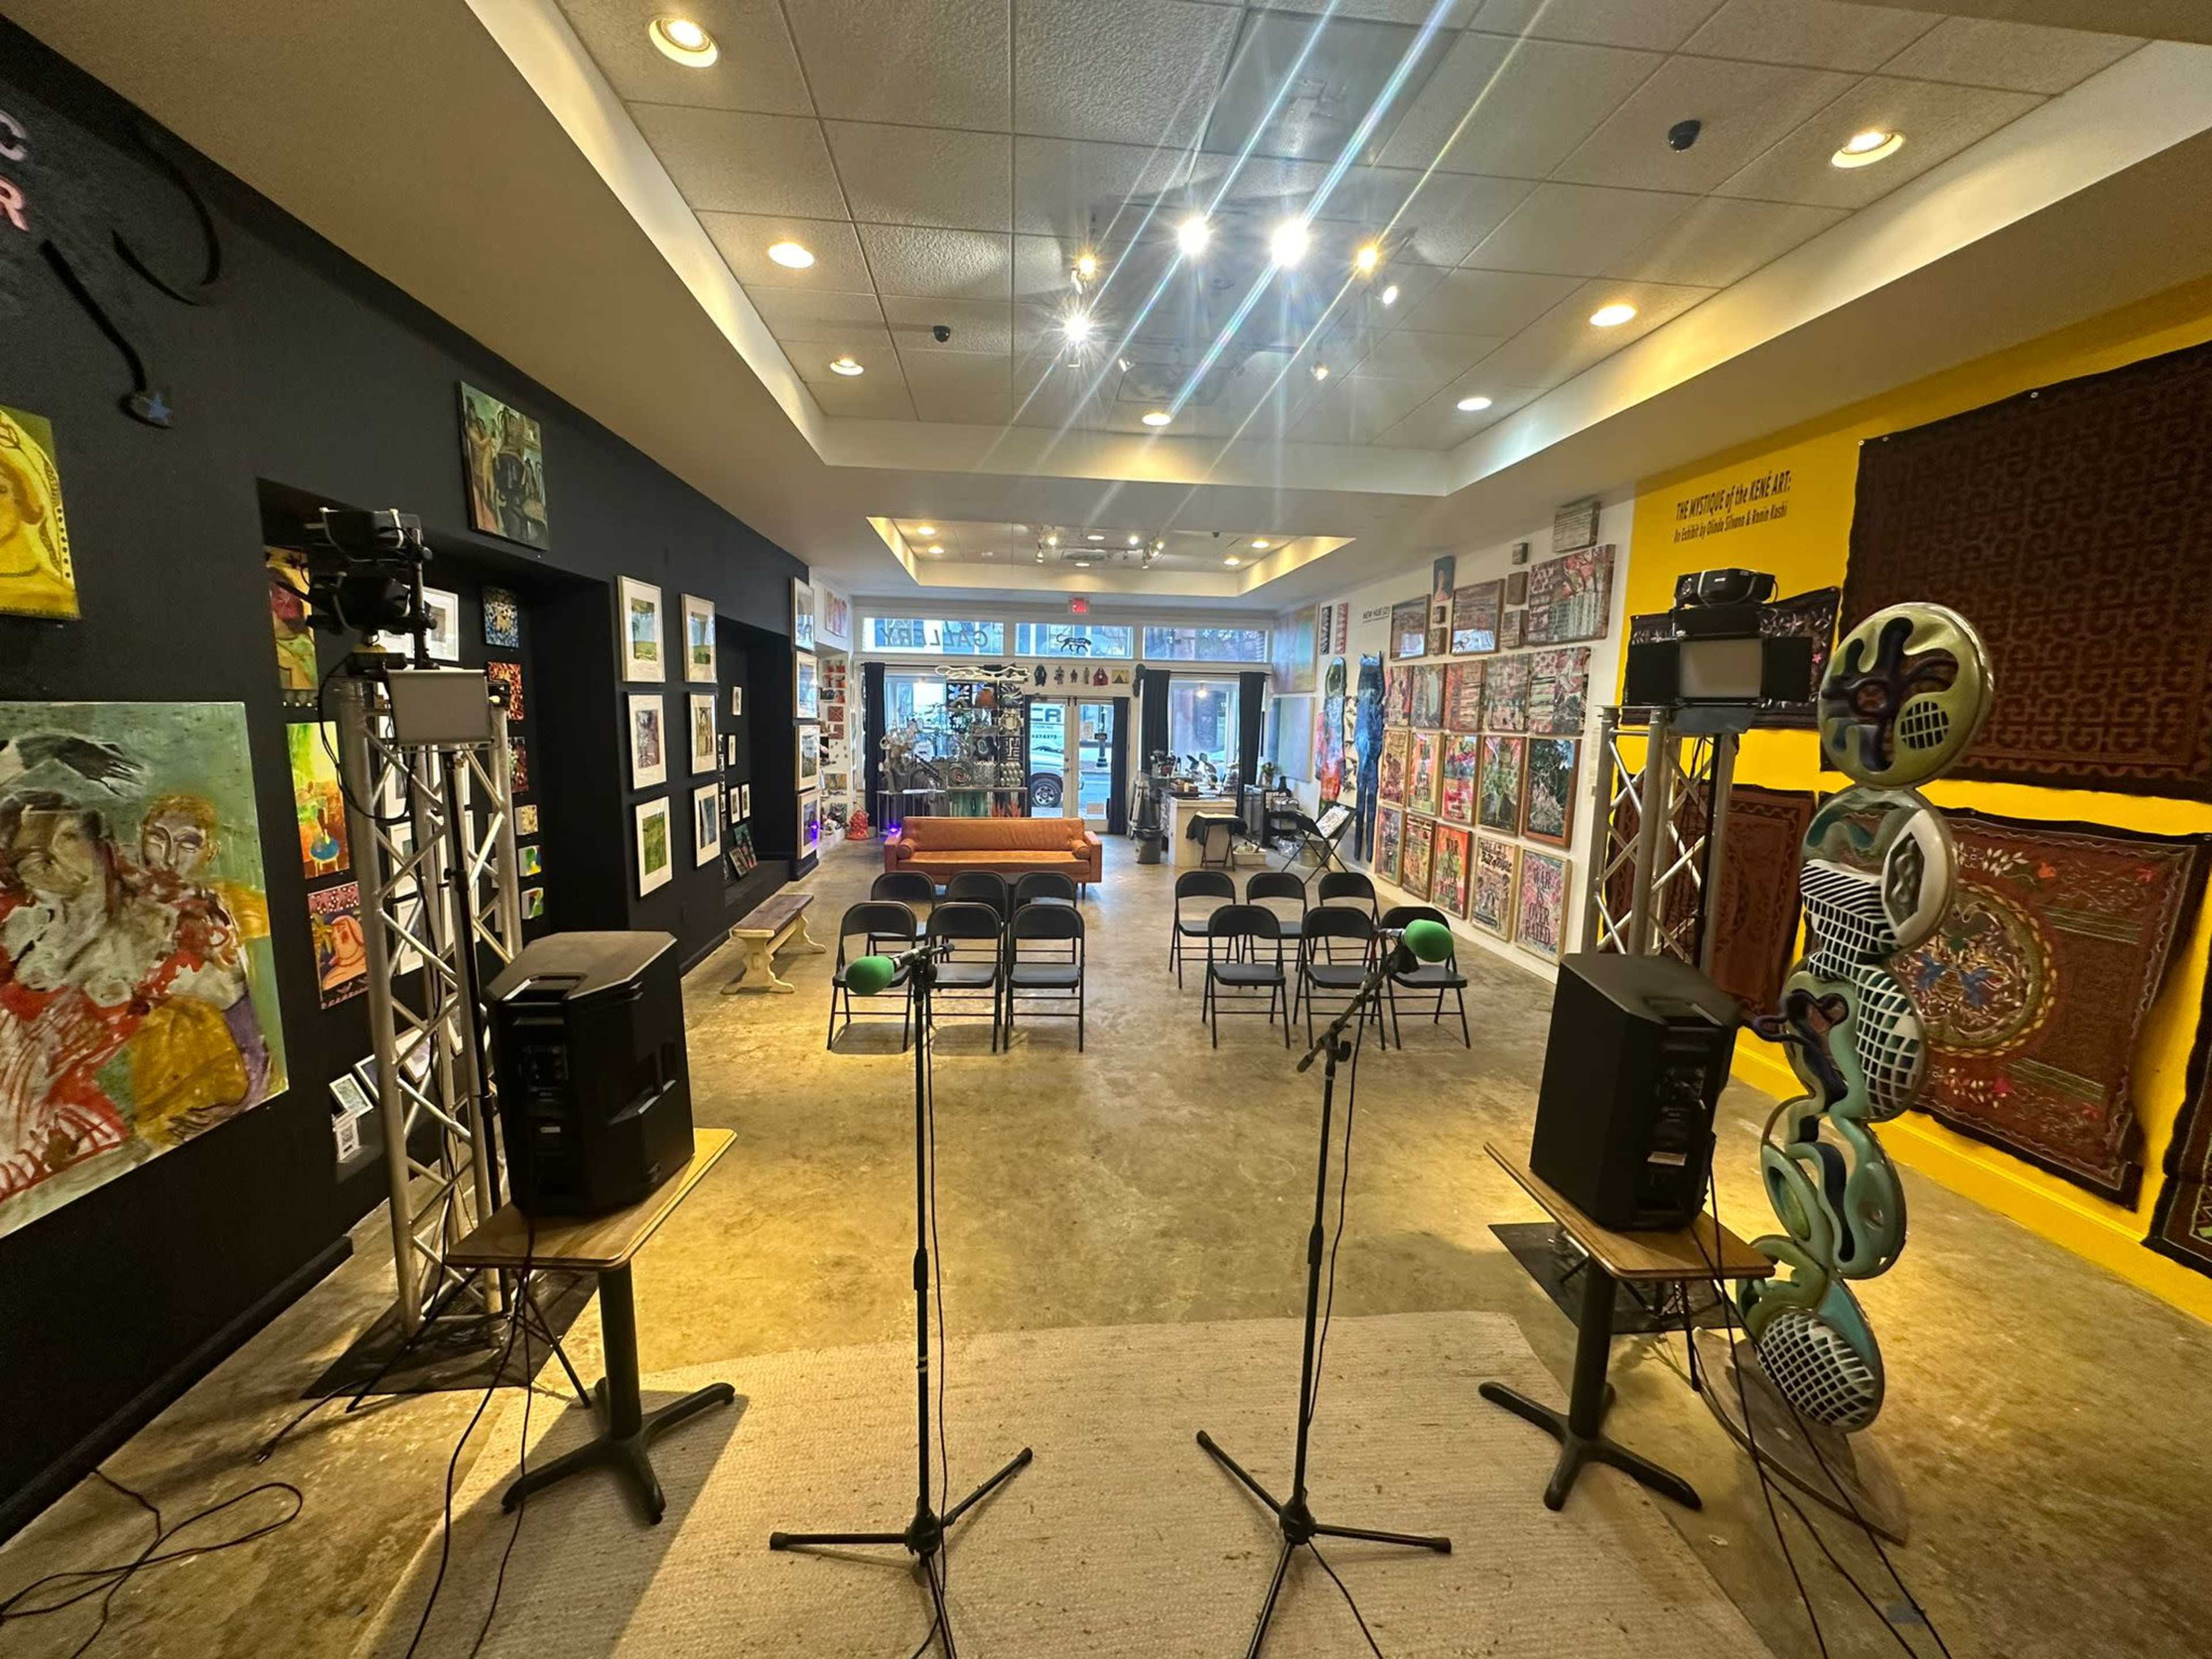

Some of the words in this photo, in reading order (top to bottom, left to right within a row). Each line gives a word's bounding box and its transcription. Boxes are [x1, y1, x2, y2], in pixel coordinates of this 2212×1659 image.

[1676, 500, 1690, 521] THE
[1689, 489, 1725, 517] MYSTIQUE
[1725, 485, 1736, 514] of
[1734, 484, 1748, 505] the
[1680, 524, 1699, 542] Exhibit
[1699, 522, 1706, 540] by
[1529, 902, 1550, 926] OVER
[1525, 919, 1551, 946] RATED
